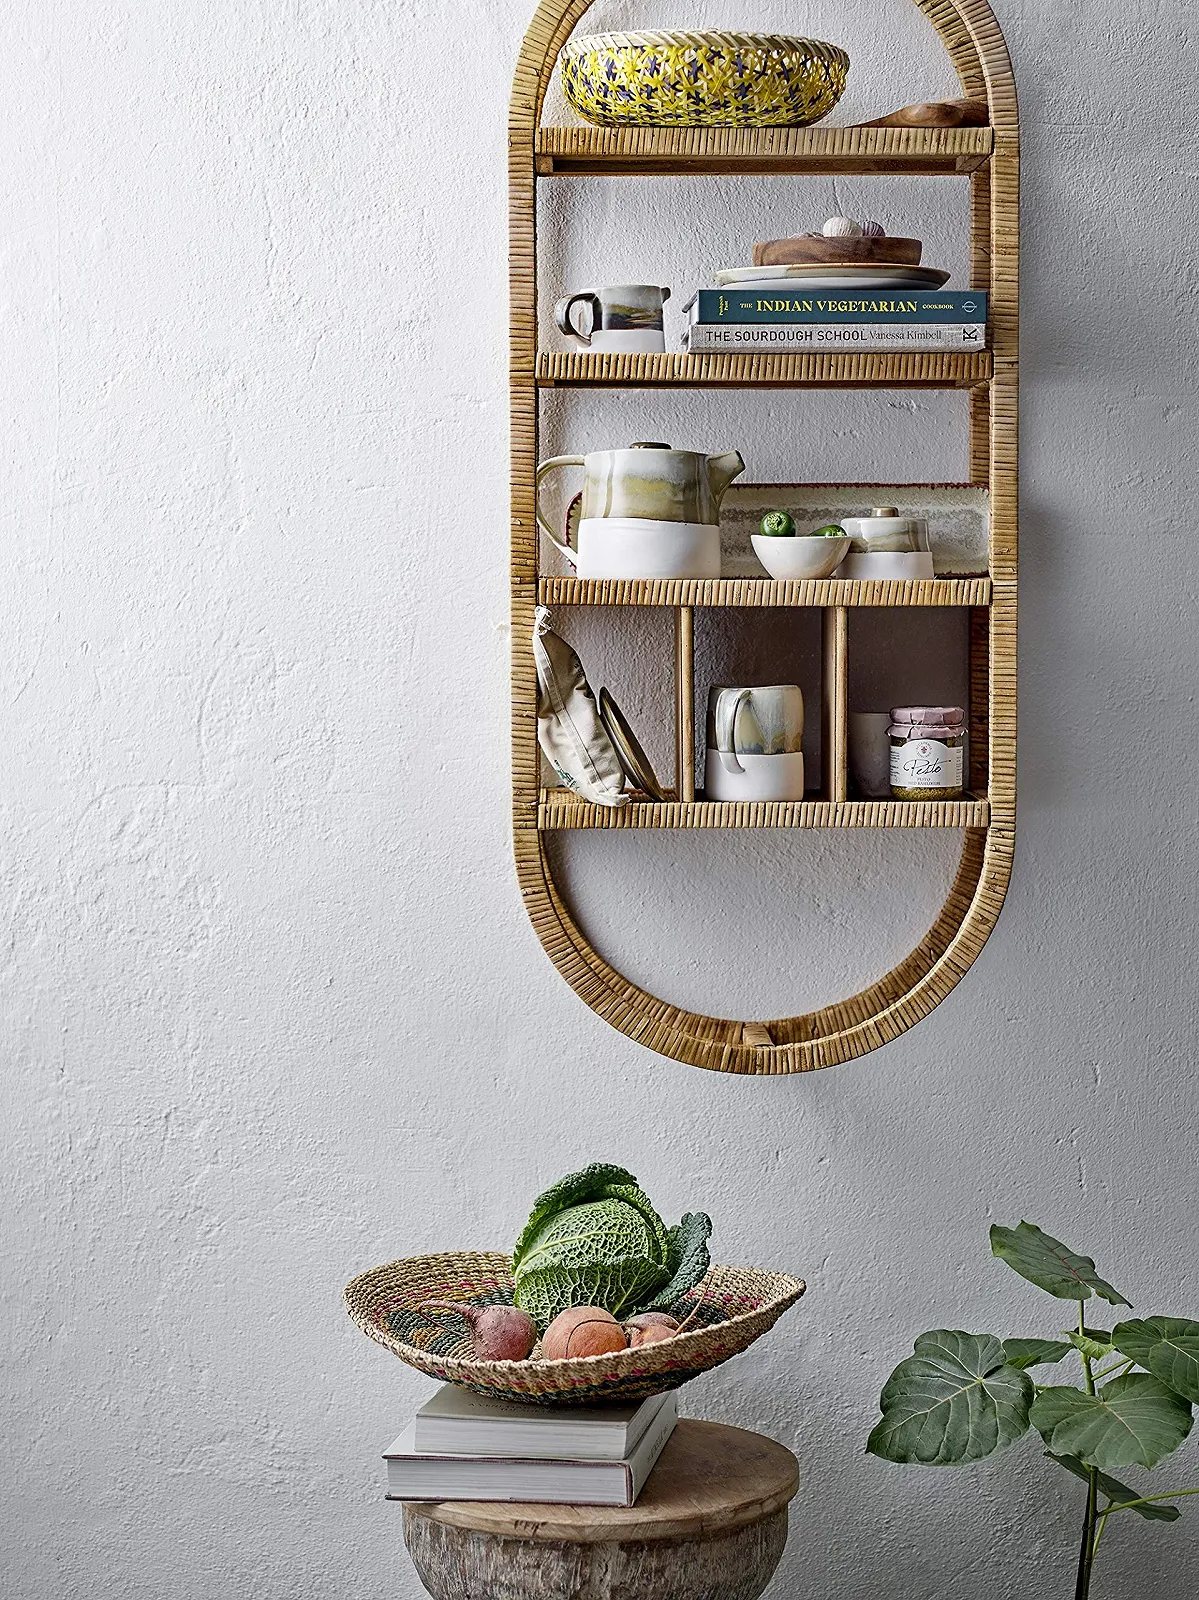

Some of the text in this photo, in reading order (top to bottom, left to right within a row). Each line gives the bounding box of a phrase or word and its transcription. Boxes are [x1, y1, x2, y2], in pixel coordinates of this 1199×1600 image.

[756, 299, 813, 312] INDIAN
[816, 300, 918, 312] VEGETARIAN
[706, 330, 941, 342] THE SOURDOUGH SCHOOL Vanessa Kimbell
[903, 758, 951, 776] Pesto
